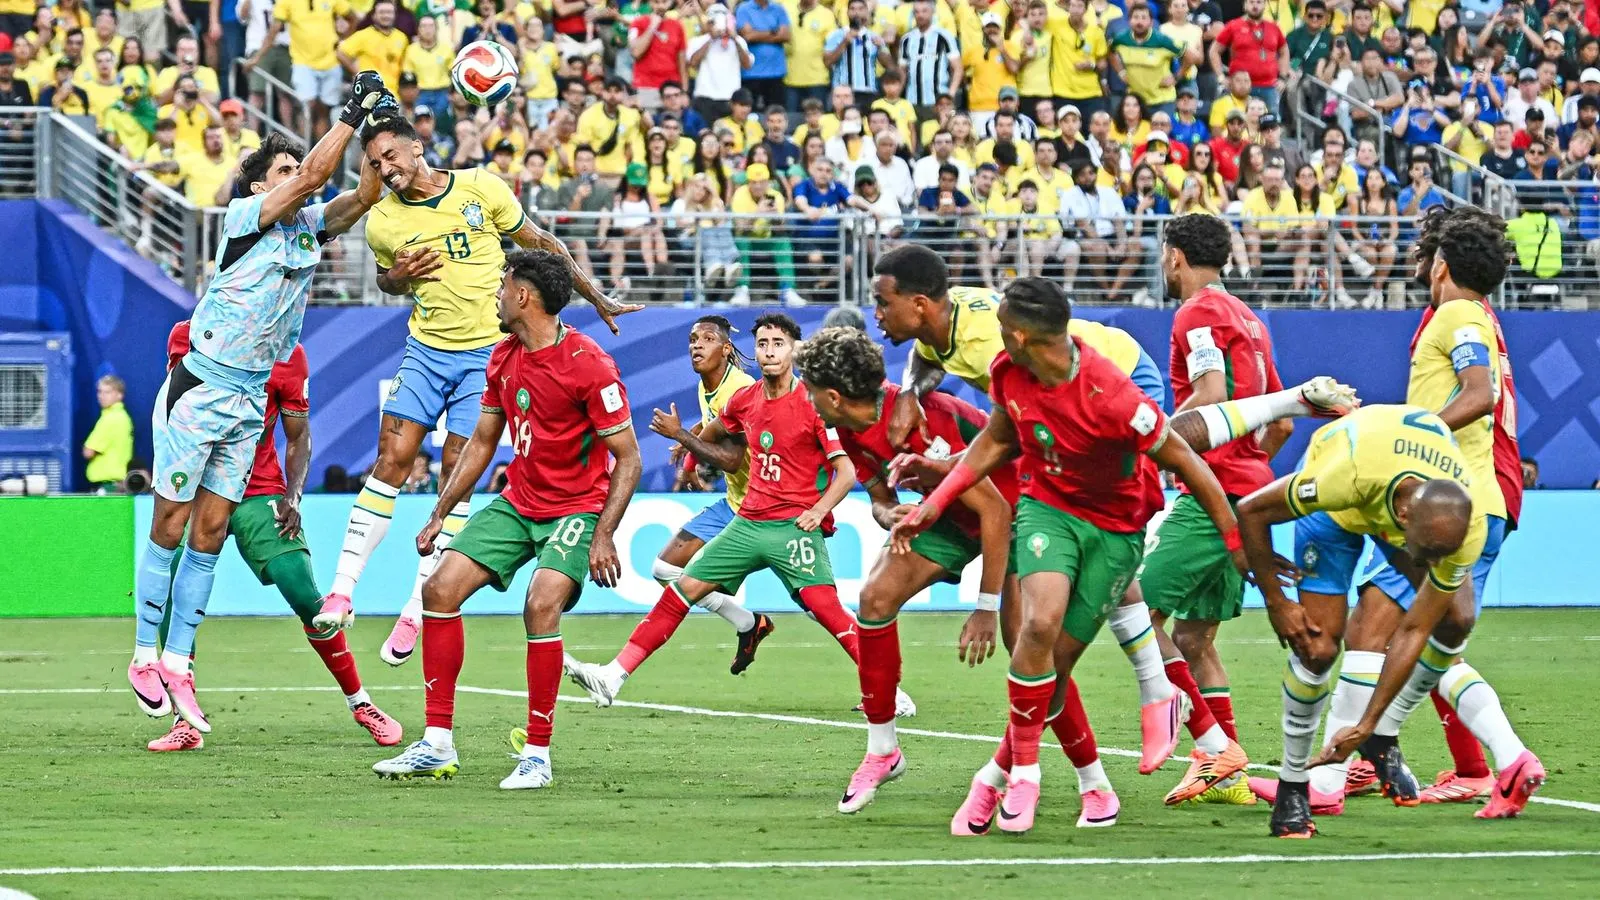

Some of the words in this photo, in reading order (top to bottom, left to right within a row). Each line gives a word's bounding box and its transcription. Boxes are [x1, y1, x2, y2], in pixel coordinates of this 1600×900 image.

[445, 232, 471, 259] 13
[513, 416, 532, 458] 18
[757, 453, 781, 482] 26
[546, 516, 585, 547] 18
[786, 536, 816, 568] 26
